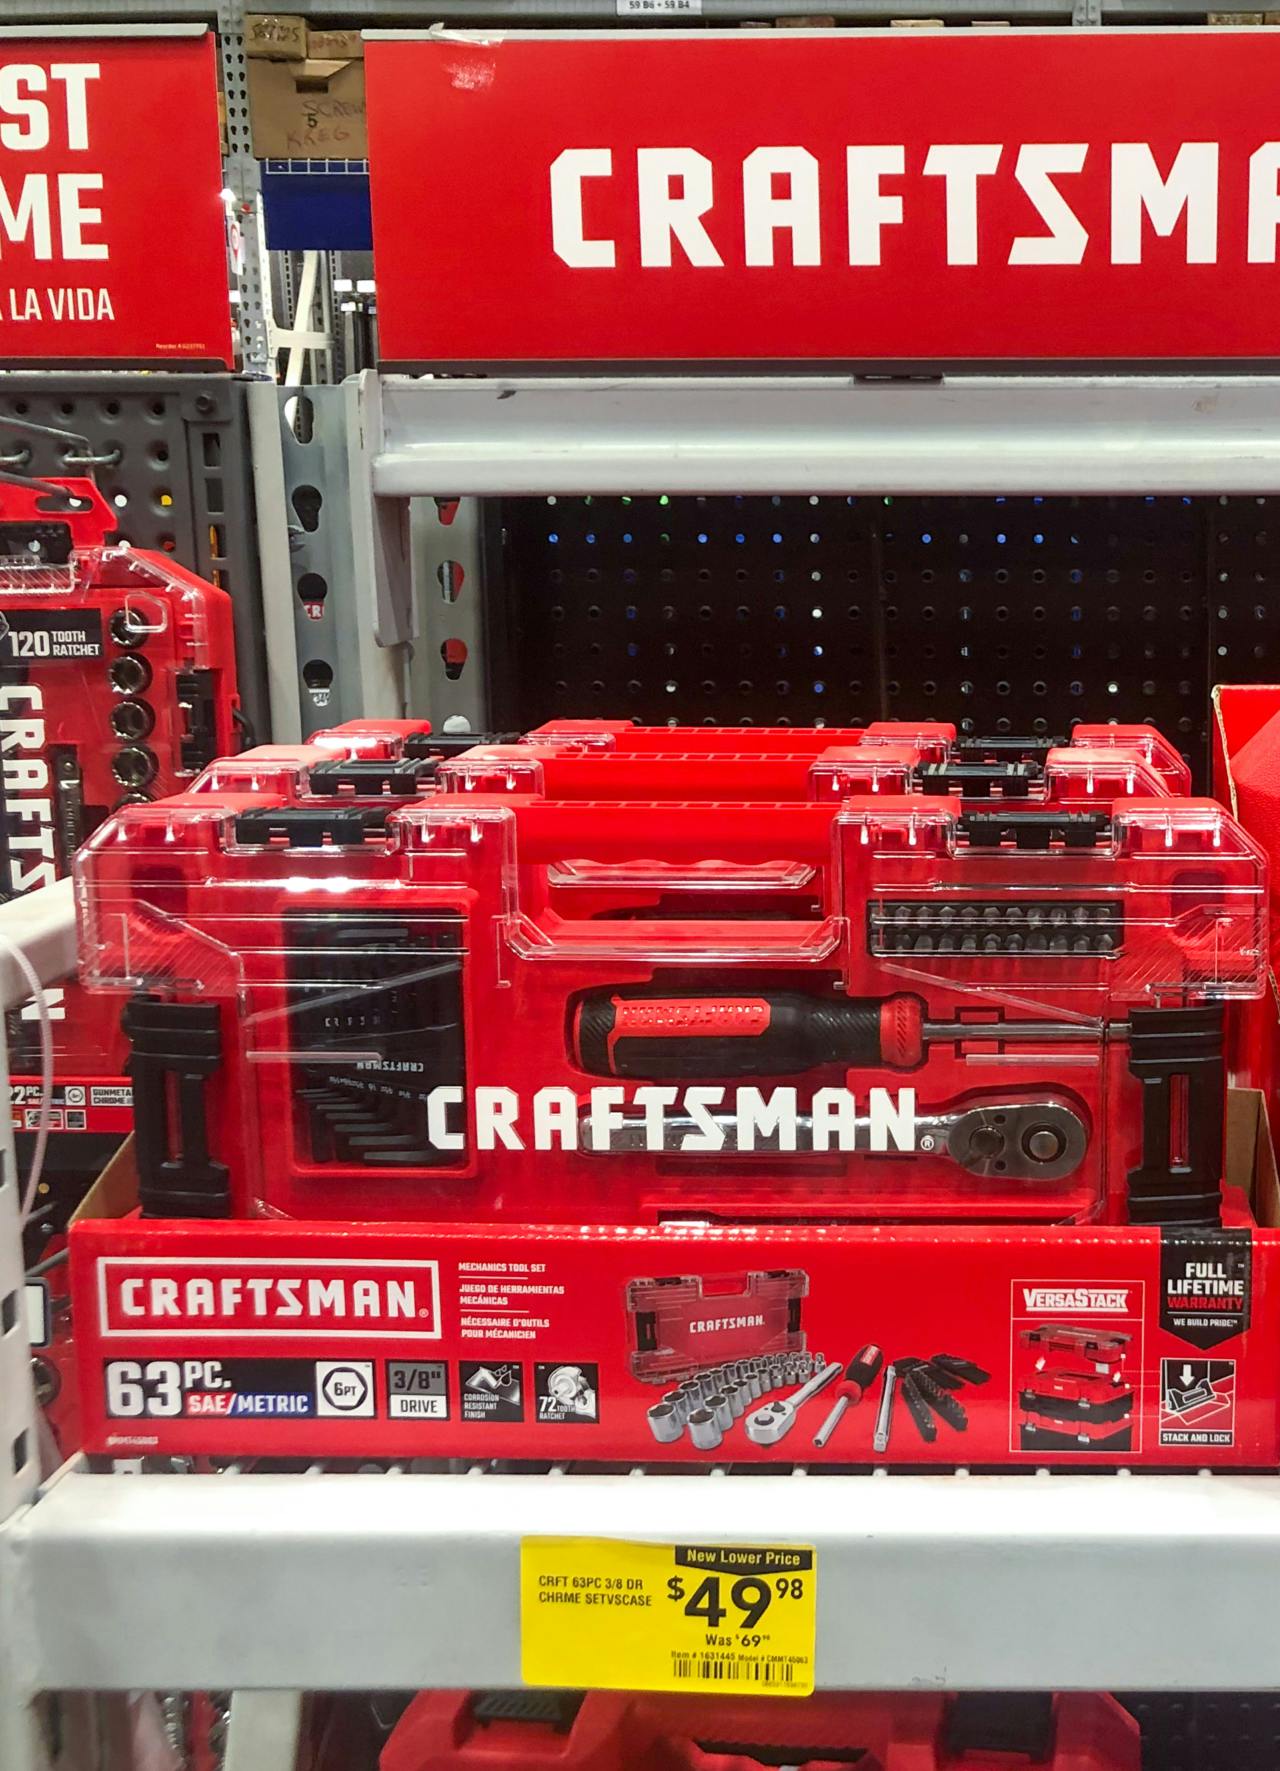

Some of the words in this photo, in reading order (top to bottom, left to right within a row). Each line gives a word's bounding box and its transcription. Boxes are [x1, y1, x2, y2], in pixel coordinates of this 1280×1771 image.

[0, 63, 100, 150] ST
[307, 113, 318, 127] 5
[9, 288, 42, 320] LA
[47, 288, 115, 321] VIDA
[8, 631, 49, 657] 120
[52, 630, 86, 643] TOOTH
[53, 643, 100, 656] RATCHET
[92, 1088, 133, 1096] GUNMETA
[458, 1262, 507, 1272] MECHANICS
[508, 1263, 529, 1272] TOOL
[531, 1263, 546, 1273] SET
[1185, 1262, 1227, 1278] FULL
[459, 1284, 486, 1293] JUEGO
[487, 1284, 498, 1293] DE
[500, 1285, 564, 1295] HERRAMIENTAS
[1167, 1279, 1244, 1295] LIFETIME
[1167, 1296, 1243, 1310] WARRANTY
[1173, 1318, 1186, 1326] WE
[1187, 1318, 1208, 1326] BUILD
[461, 1328, 483, 1338] POUR
[485, 1328, 536, 1339] MÉCANICIEN
[183, 1360, 232, 1389] PC.
[105, 1361, 183, 1417] 63
[187, 1392, 309, 1415] SAE/METRIC
[464, 1393, 499, 1401] CORROSION
[538, 1396, 557, 1412] 72
[400, 1399, 438, 1413] DRIVE
[464, 1402, 497, 1410] RESISTANT
[464, 1411, 486, 1419] FINISH
[539, 1412, 565, 1420] RATCHET
[1162, 1432, 1189, 1443] STACK
[1190, 1432, 1208, 1443] AND
[1209, 1432, 1230, 1443] LOCK
[687, 1549, 715, 1563] New
[720, 1550, 762, 1565] Lower
[765, 1552, 801, 1566] Price
[538, 1575, 568, 1587] CRFT
[572, 1576, 602, 1588] 63PC
[604, 1577, 623, 1590] 3/8
[626, 1578, 643, 1590] DR
[538, 1591, 582, 1604] CHRME
[585, 1593, 652, 1607] SETVSCASE
[705, 1633, 732, 1646] Was
